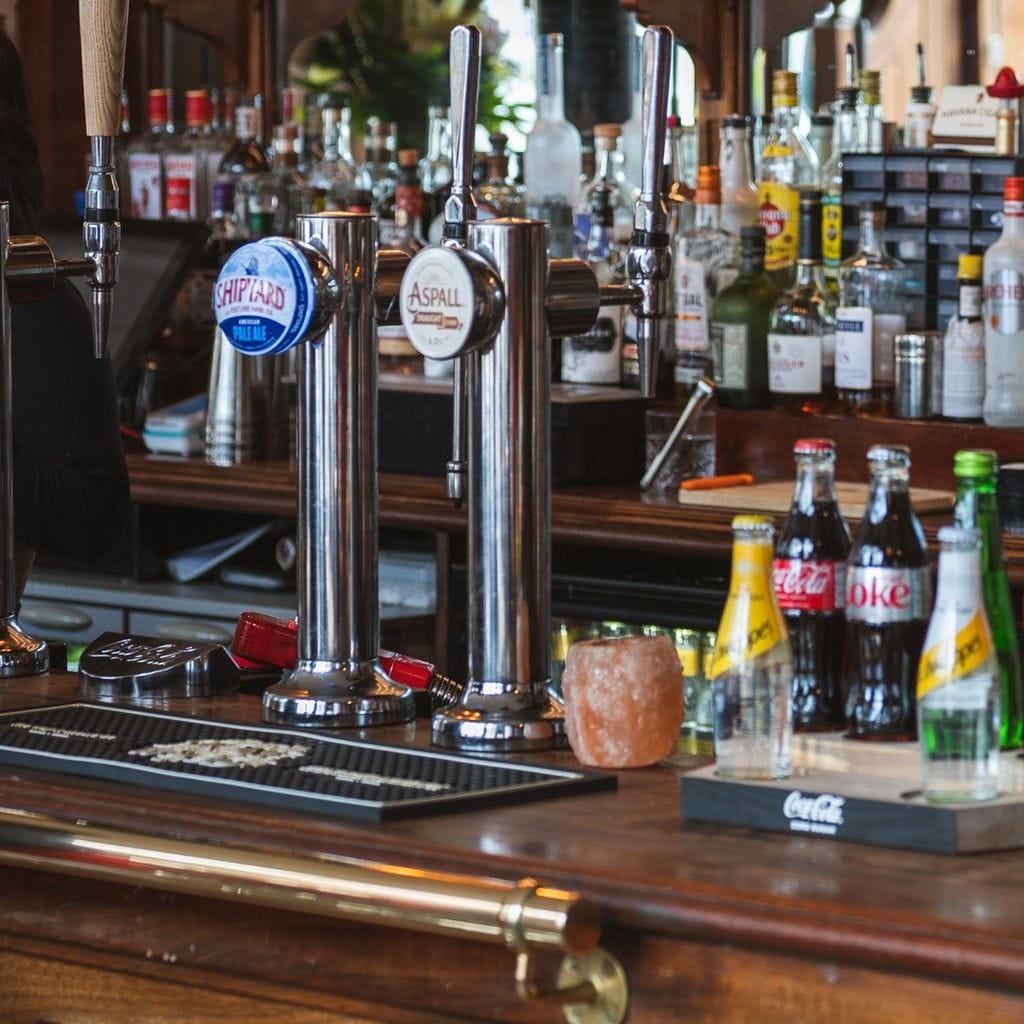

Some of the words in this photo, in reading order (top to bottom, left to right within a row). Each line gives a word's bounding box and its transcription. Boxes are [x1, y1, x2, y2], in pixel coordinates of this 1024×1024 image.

[216, 278, 285, 310] SHIPYARD
[407, 281, 463, 312] ASPALL
[233, 326, 251, 341] PALE
[253, 326, 267, 341] ALE
[848, 575, 911, 610] oke
[783, 790, 845, 824] Coca-Cola
